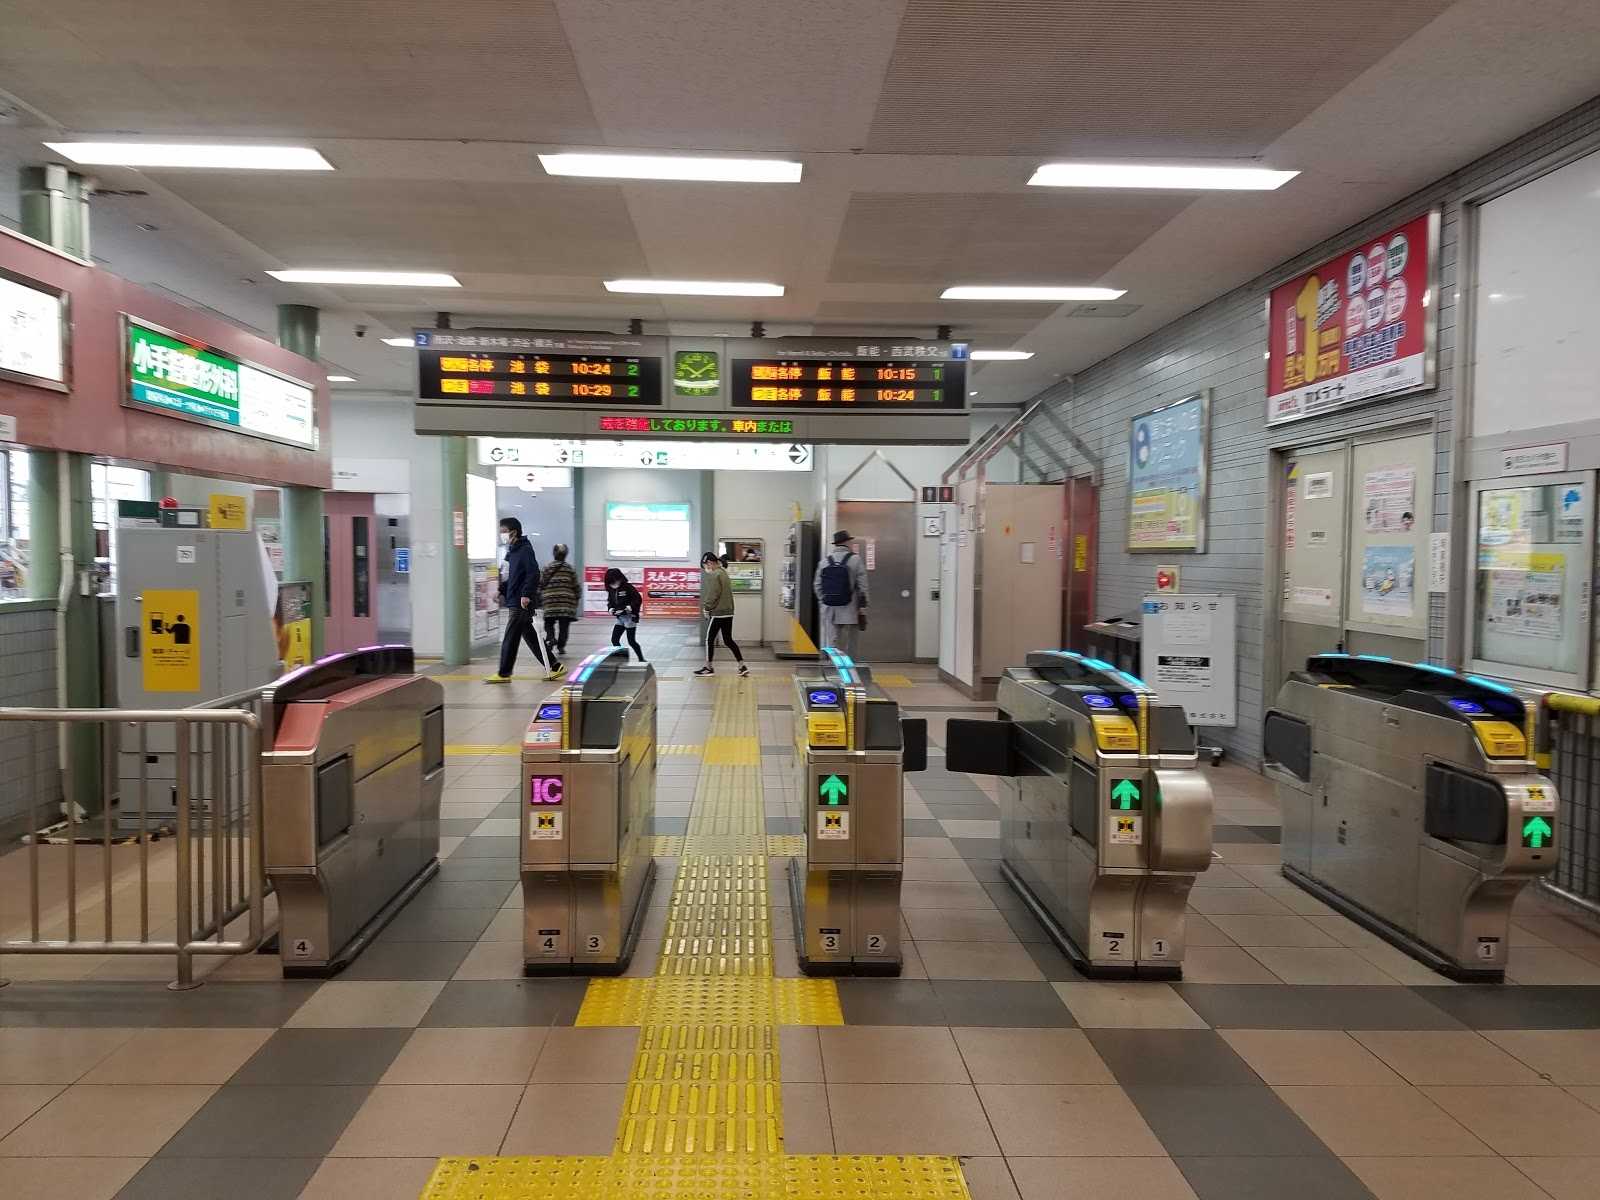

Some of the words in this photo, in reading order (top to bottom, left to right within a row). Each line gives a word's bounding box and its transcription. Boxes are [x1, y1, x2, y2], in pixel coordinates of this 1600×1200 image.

[417, 334, 427, 345] 2
[571, 363, 612, 375] 10:24
[628, 364, 639, 376] 2
[876, 368, 916, 380] 10:15
[932, 368, 940, 380] 1
[571, 384, 612, 396] 10:29
[628, 384, 639, 396] 2
[876, 389, 916, 401] 10:24
[932, 389, 940, 401] 1
[532, 778, 562, 802] IC
[296, 941, 308, 952] 4
[544, 937, 554, 948] 4
[589, 936, 599, 948] 3
[826, 936, 836, 947] 3
[870, 936, 880, 947] 2
[1109, 940, 1119, 951] 2
[1155, 941, 1163, 951] 1
[1483, 944, 1491, 955] 1
